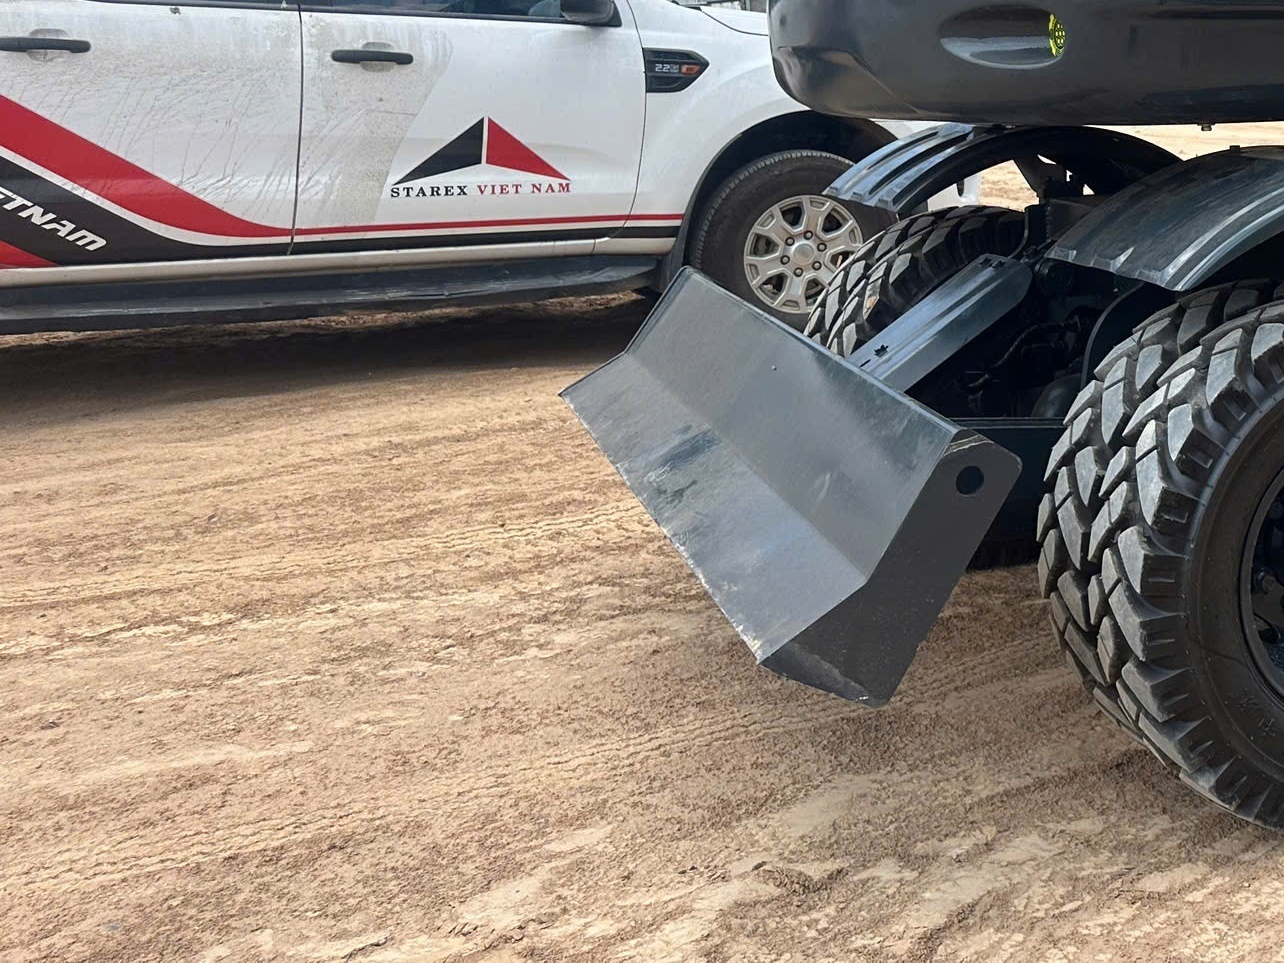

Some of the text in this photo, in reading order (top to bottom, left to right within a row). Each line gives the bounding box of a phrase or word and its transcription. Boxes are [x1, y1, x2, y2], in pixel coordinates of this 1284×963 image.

[390, 182, 571, 198] STAREX VIET NAM
